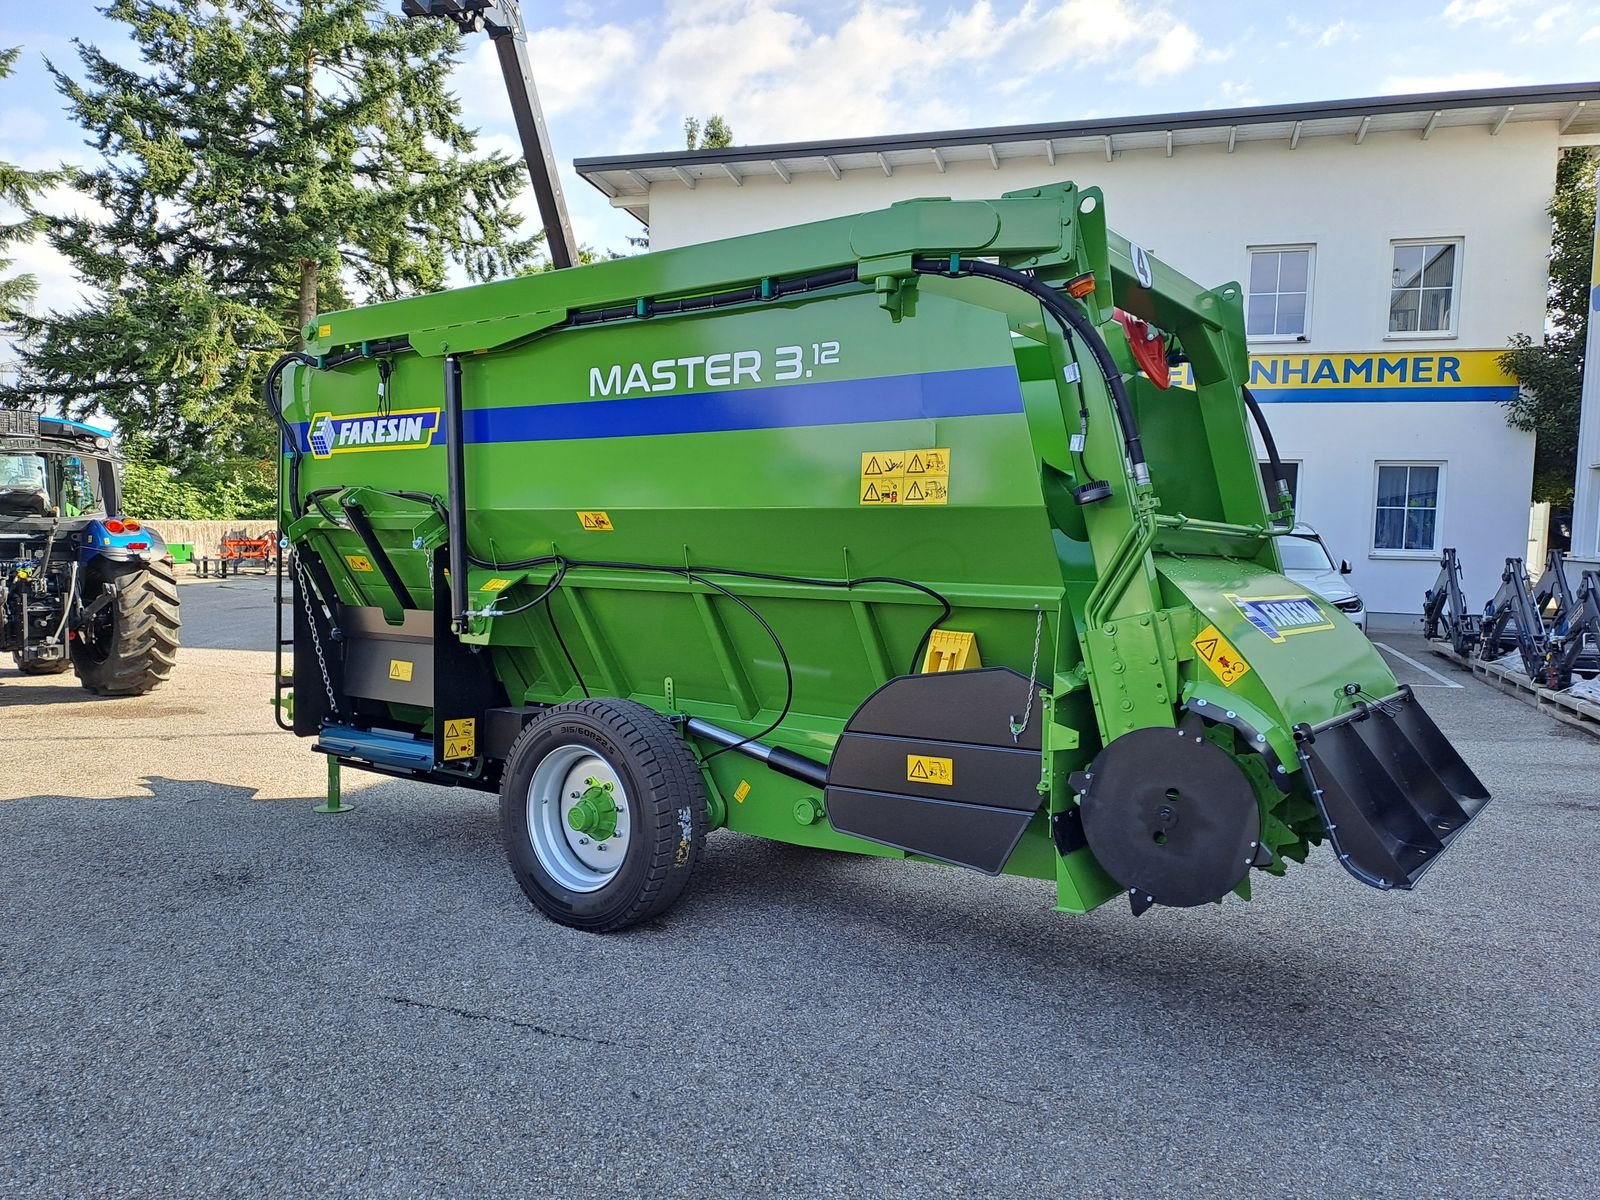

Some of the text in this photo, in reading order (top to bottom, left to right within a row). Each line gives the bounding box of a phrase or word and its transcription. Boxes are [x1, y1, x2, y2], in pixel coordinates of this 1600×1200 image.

[589, 350, 762, 397] MASTER
[338, 416, 424, 446] FARESIN
[1257, 601, 1325, 627] FARESIN
